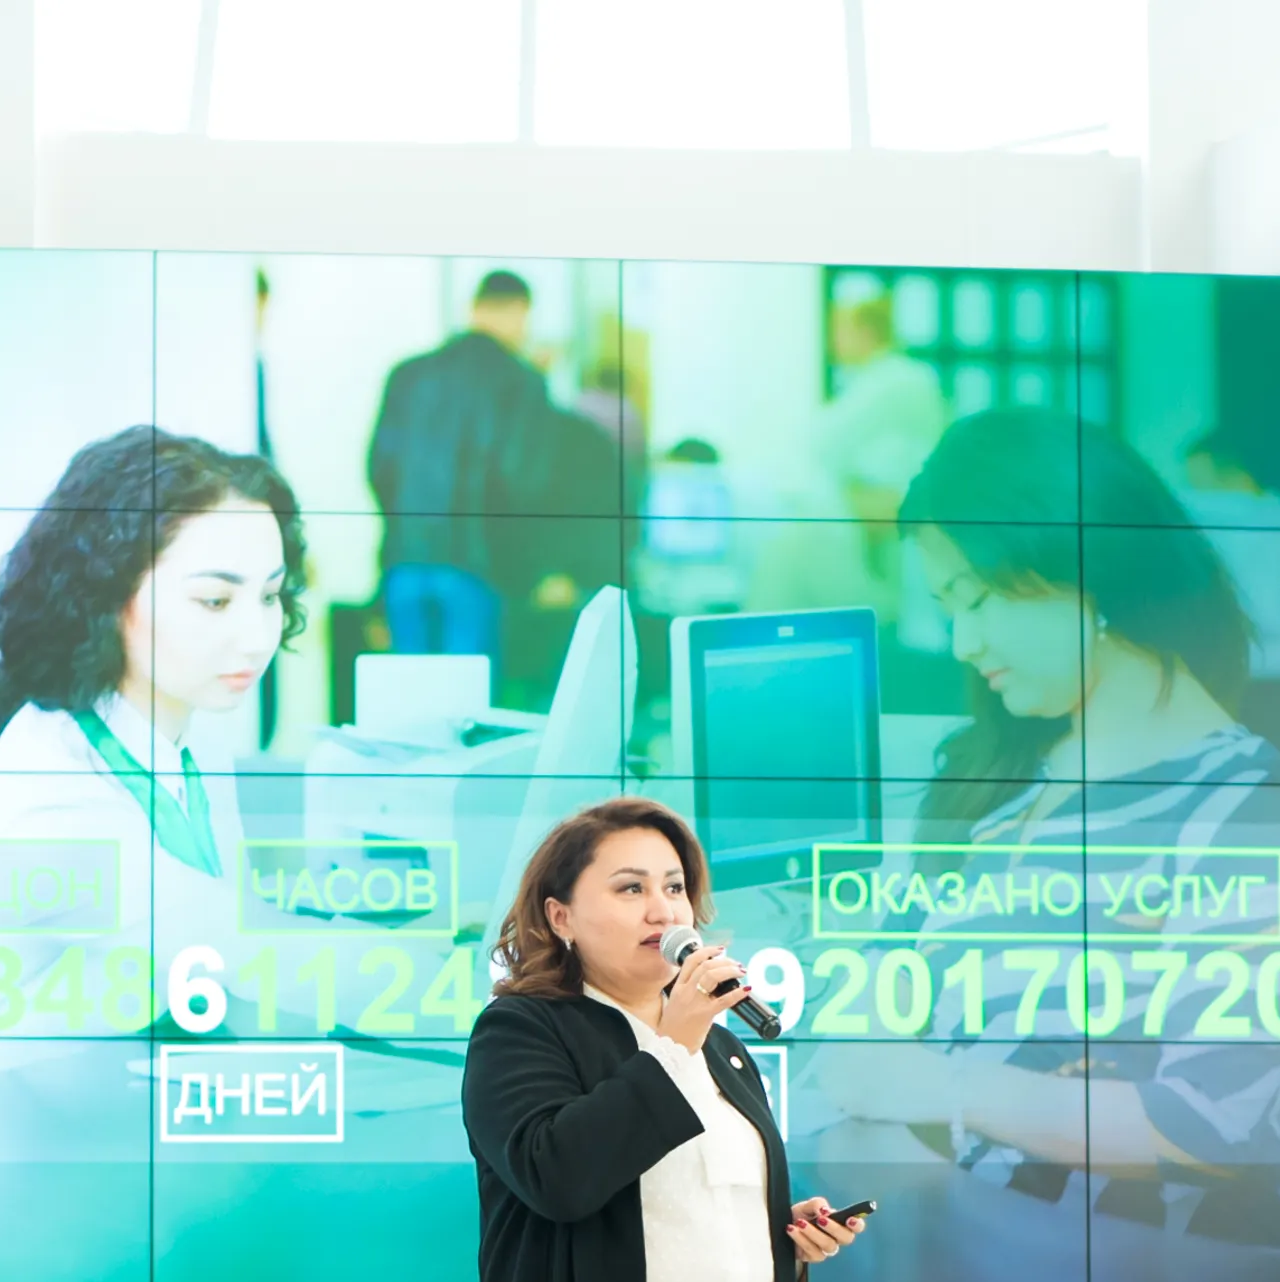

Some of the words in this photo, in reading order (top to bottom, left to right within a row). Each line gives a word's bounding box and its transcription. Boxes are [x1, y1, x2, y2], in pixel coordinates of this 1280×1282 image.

[251, 867, 439, 912] ЧАСОВ
[828, 870, 1083, 917] ОКАЗАНО
[1098, 873, 1267, 919] УСЛУГ
[173, 1062, 328, 1126] ДНЕЙ
